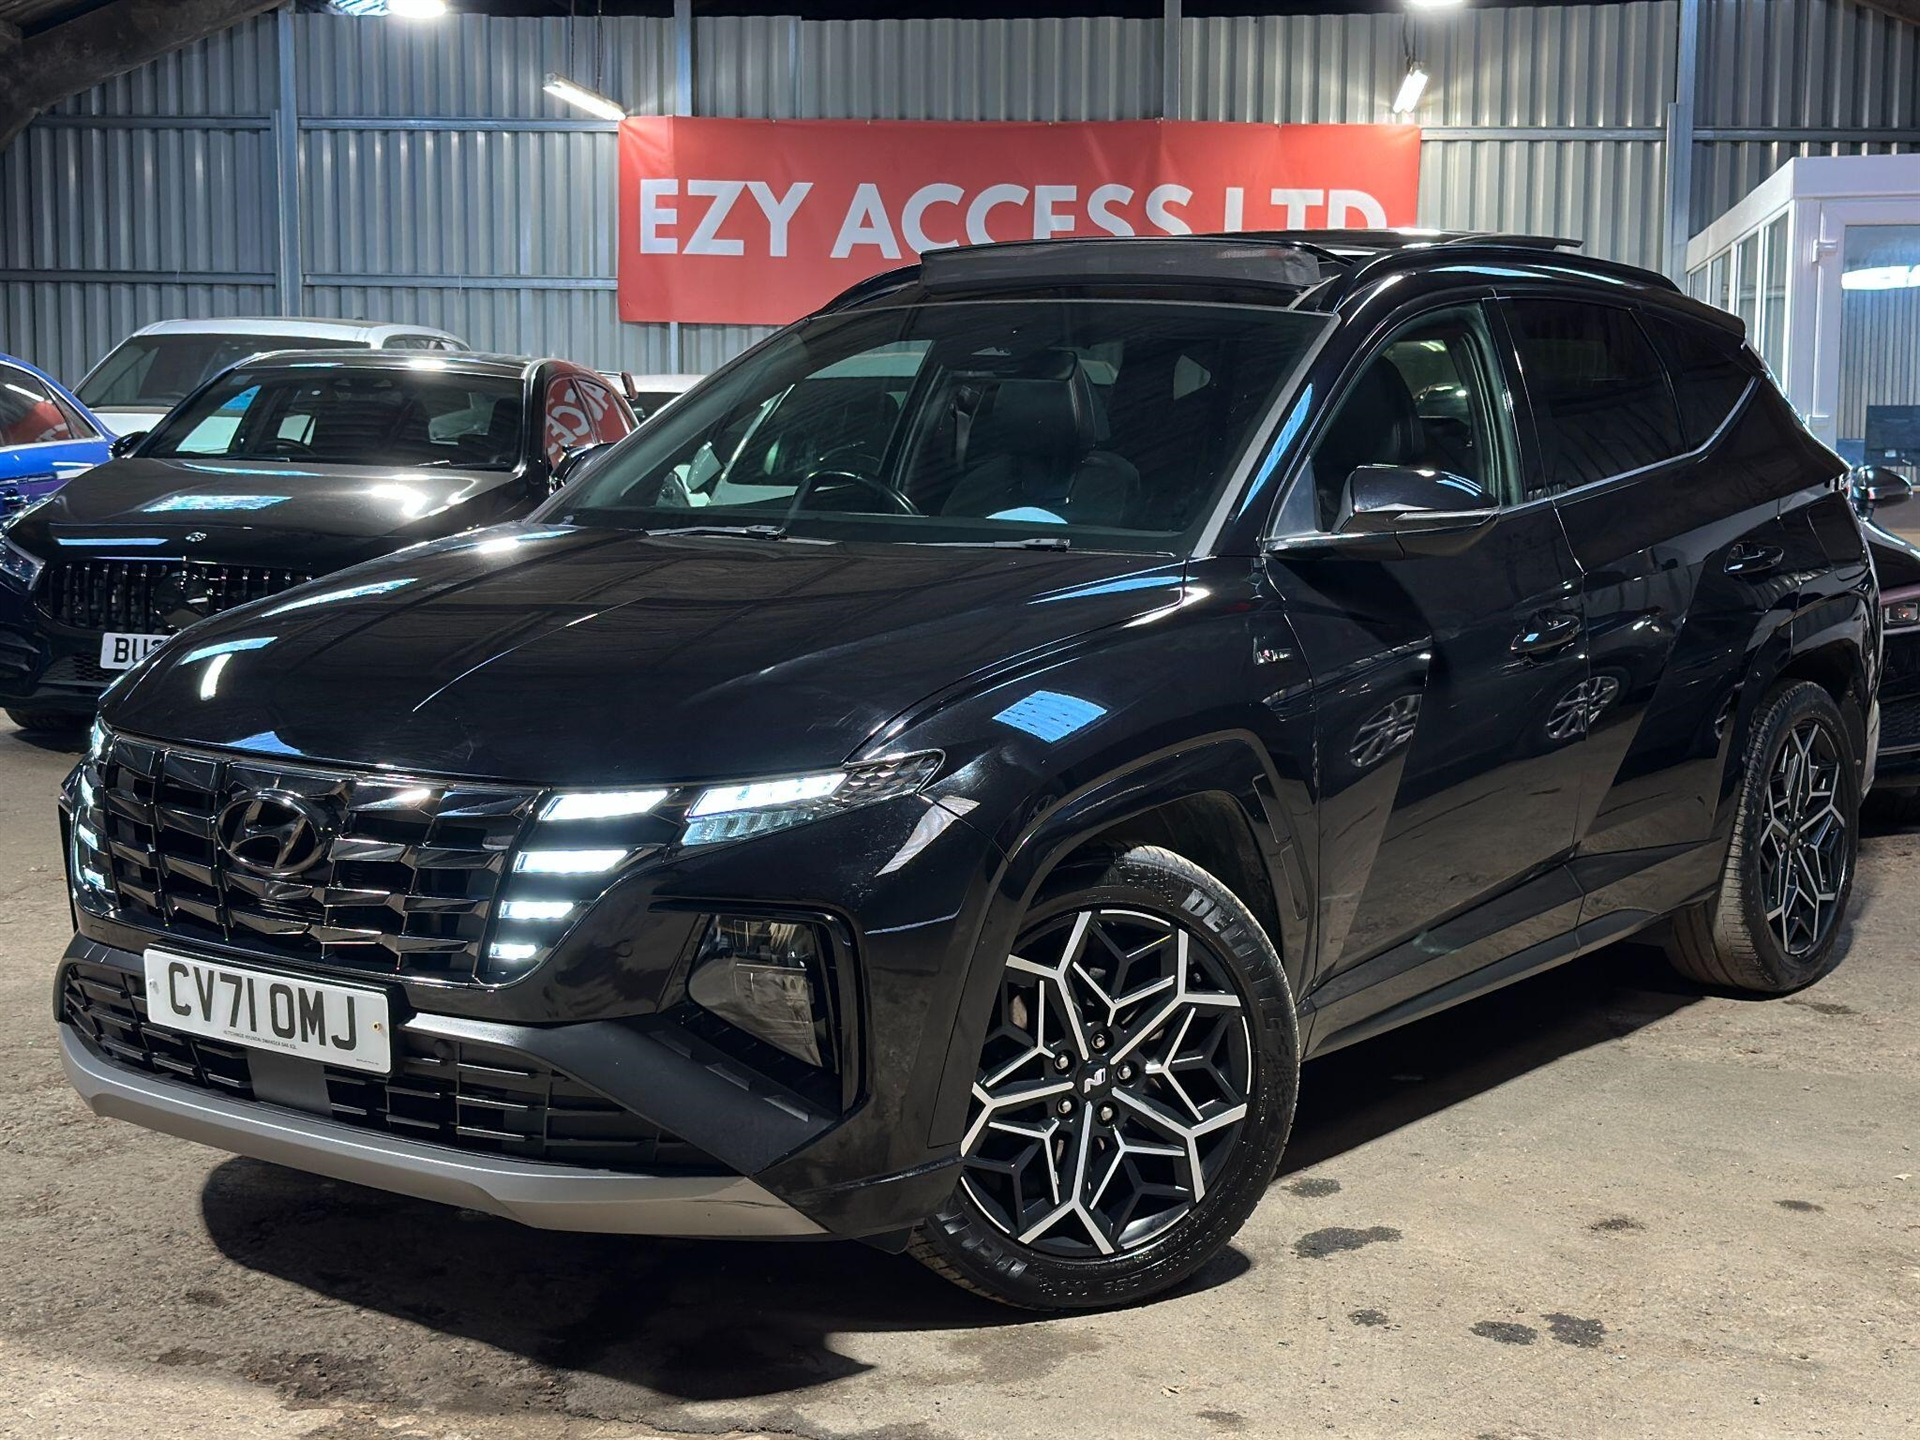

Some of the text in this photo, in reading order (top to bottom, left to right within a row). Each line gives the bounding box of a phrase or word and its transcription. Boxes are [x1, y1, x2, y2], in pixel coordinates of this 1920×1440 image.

[639, 178, 813, 257] EZY
[830, 182, 1191, 259] ACCESS
[168, 962, 357, 1051] CV71 OMJ
